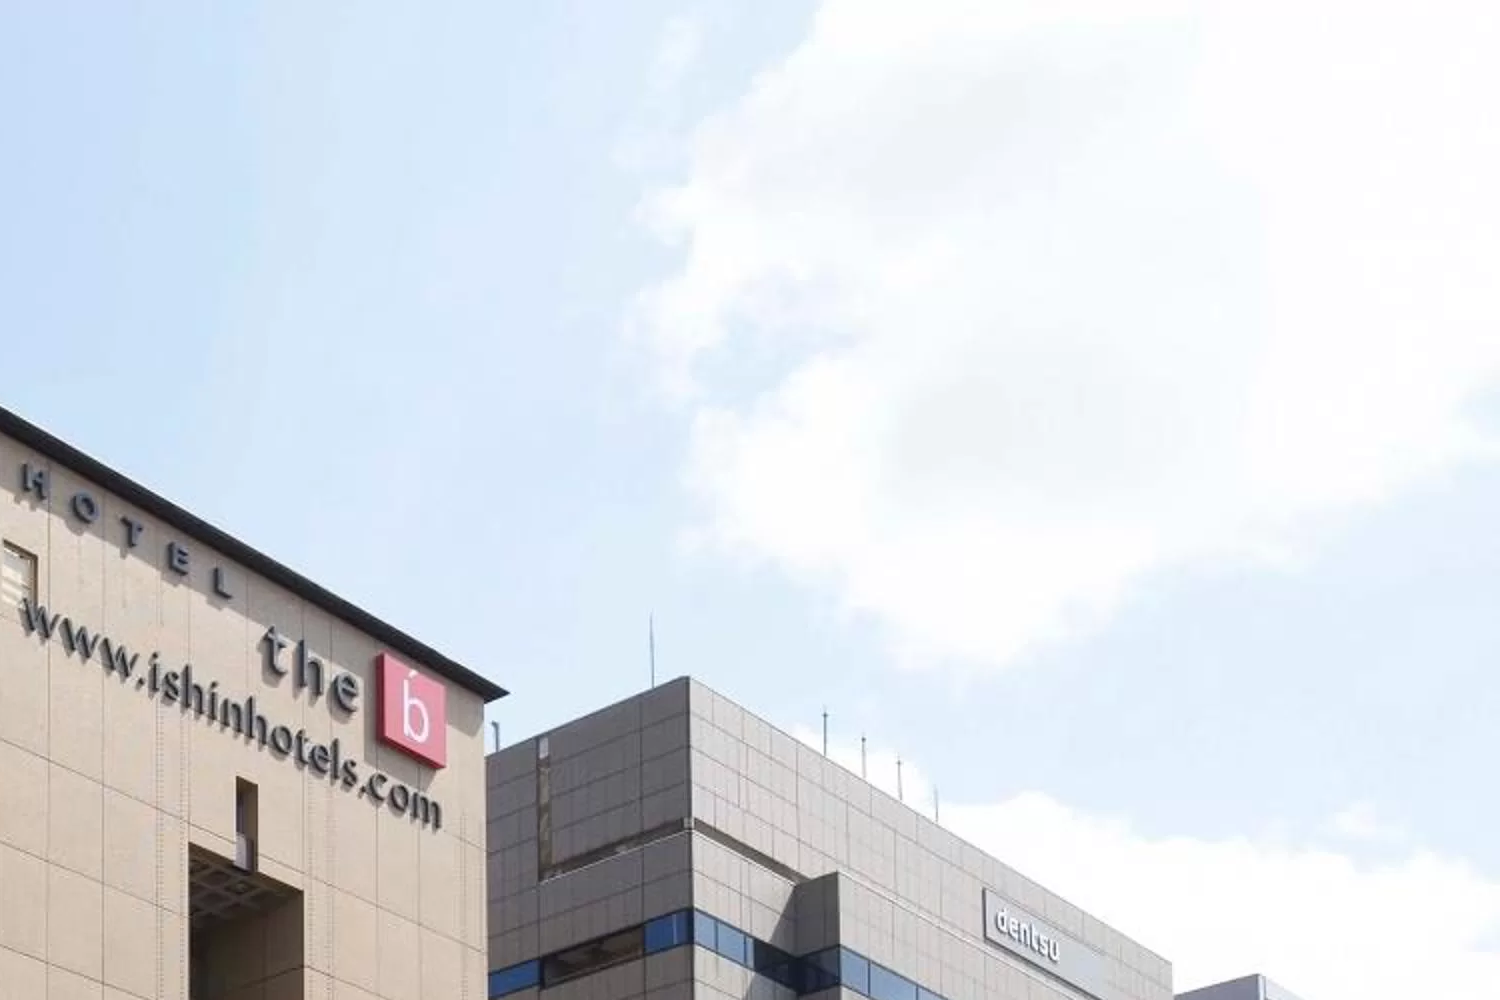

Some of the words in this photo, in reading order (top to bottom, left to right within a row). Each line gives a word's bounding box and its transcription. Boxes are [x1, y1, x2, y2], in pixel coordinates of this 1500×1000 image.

[20, 462, 233, 600] HOTEL
[264, 624, 359, 714] the
[402, 669, 430, 744] b
[22, 597, 443, 831] www.ishinhotels.com
[996, 906, 1060, 962] dentsu
